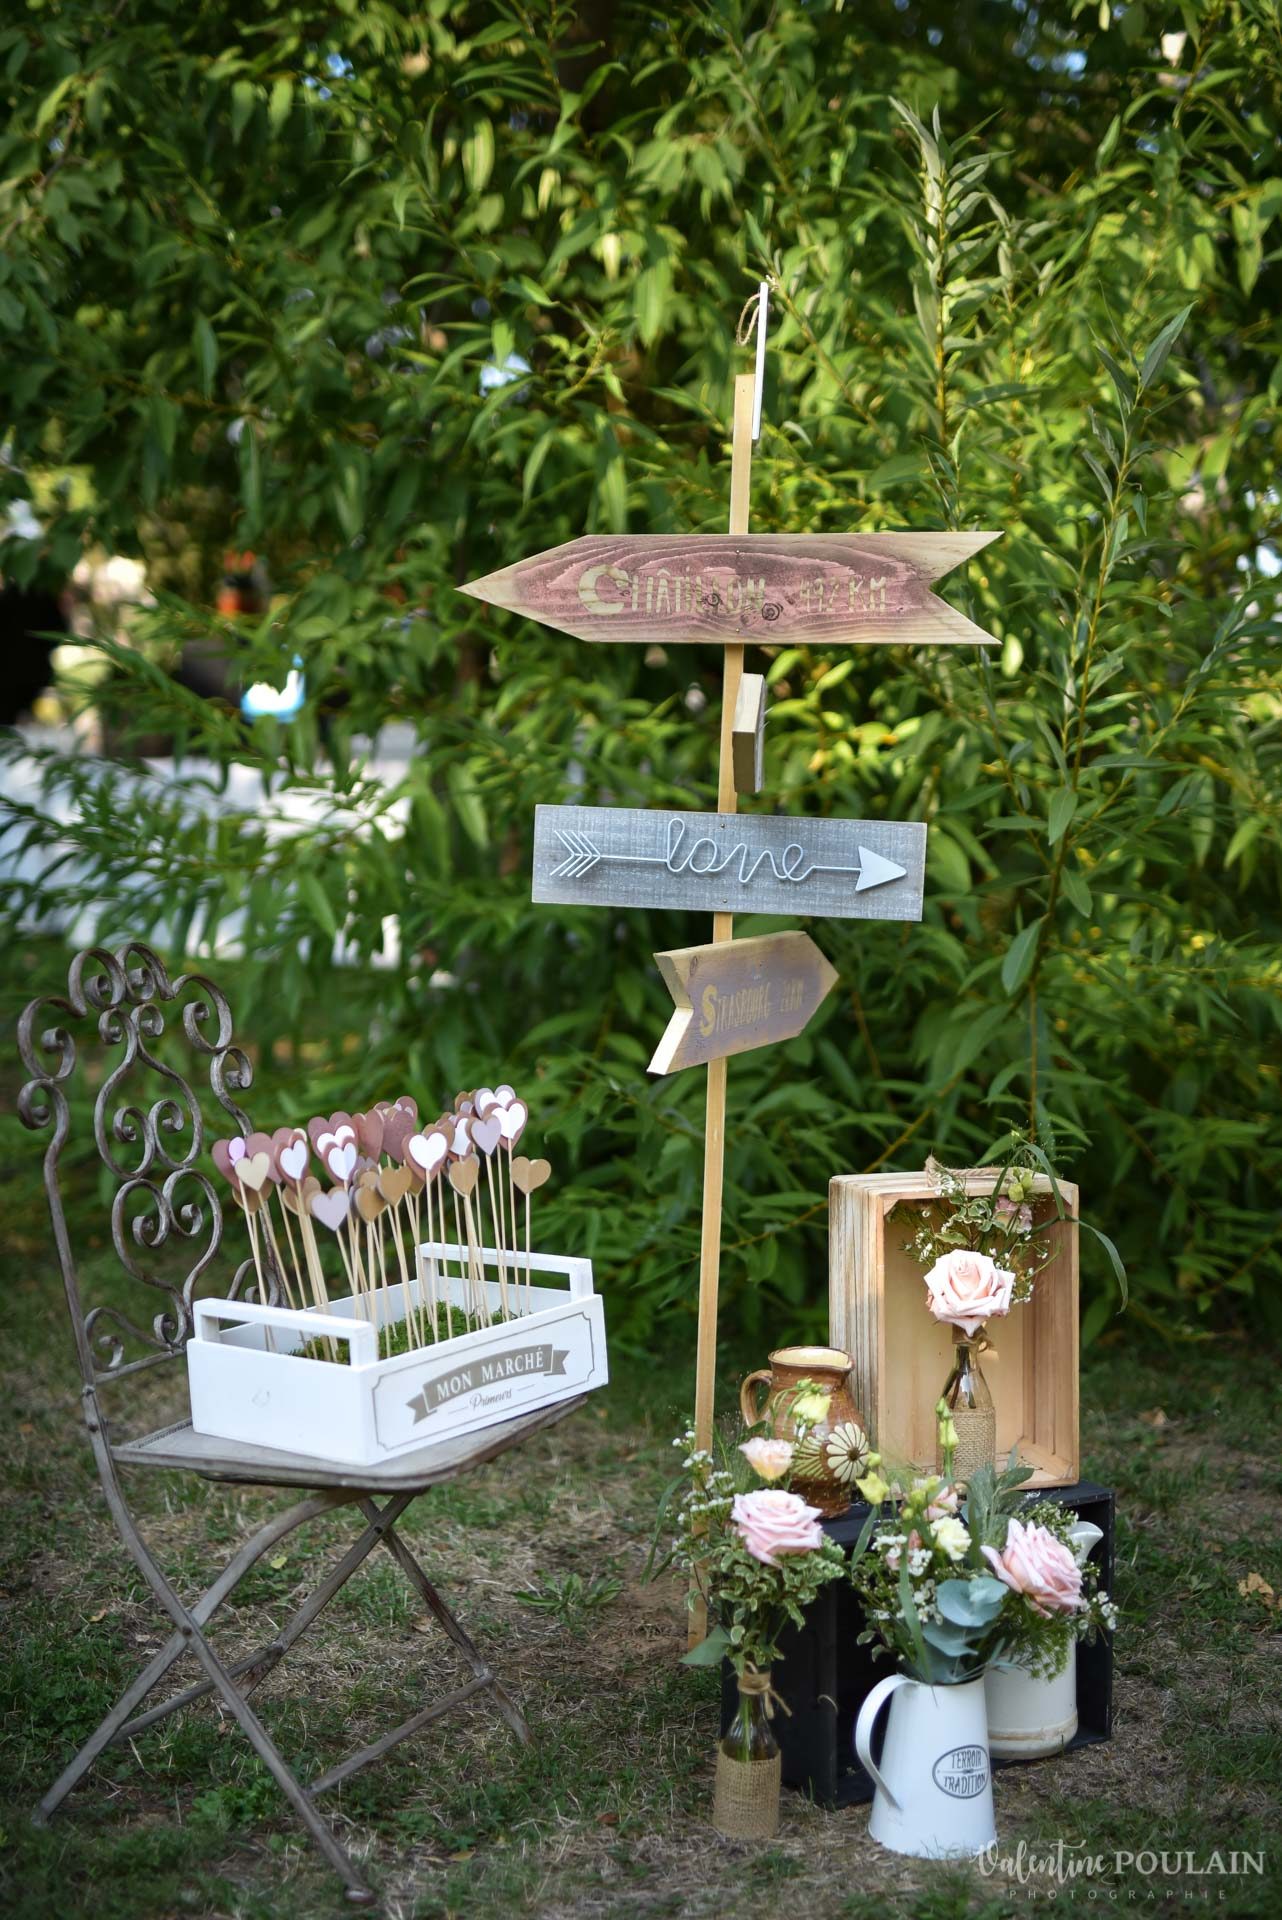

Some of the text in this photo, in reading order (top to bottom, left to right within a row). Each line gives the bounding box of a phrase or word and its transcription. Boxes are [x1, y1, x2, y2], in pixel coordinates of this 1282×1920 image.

[847, 576, 887, 612] KM
[666, 817, 814, 884] love
[436, 1346, 544, 1402] MON MARCHÉ
[470, 1388, 512, 1410] Primeurs
[951, 1749, 982, 1770] TERROIR
[943, 1774, 986, 1795] TRADITION
